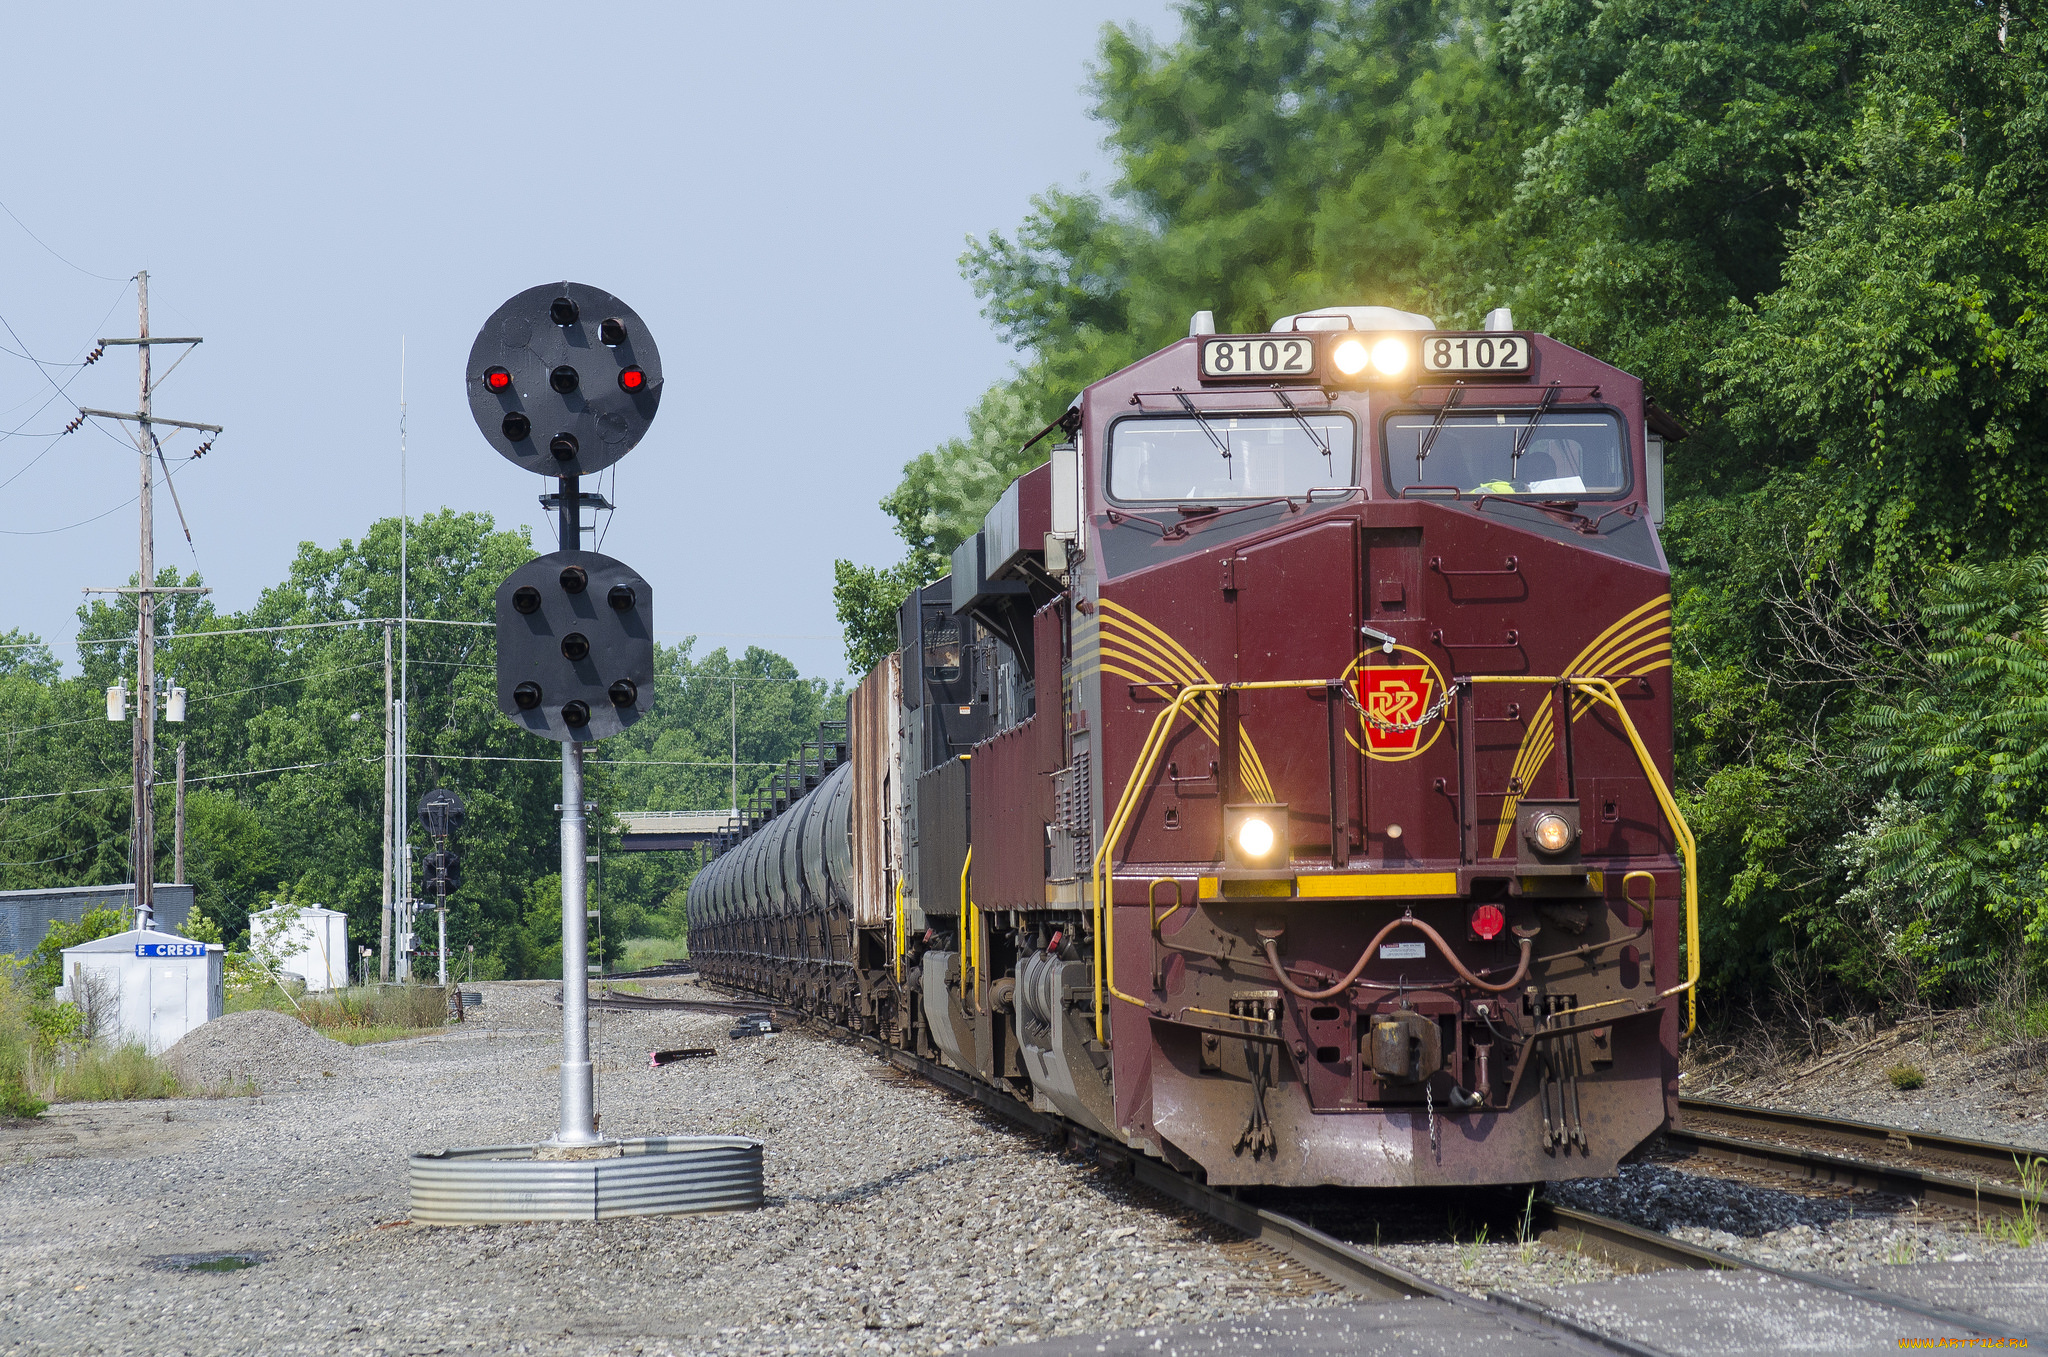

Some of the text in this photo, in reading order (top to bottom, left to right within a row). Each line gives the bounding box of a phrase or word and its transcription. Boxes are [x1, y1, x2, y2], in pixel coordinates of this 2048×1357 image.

[1215, 341, 1303, 372] 8102
[1433, 338, 1519, 369] 8102
[138, 944, 203, 956] E. CREST
